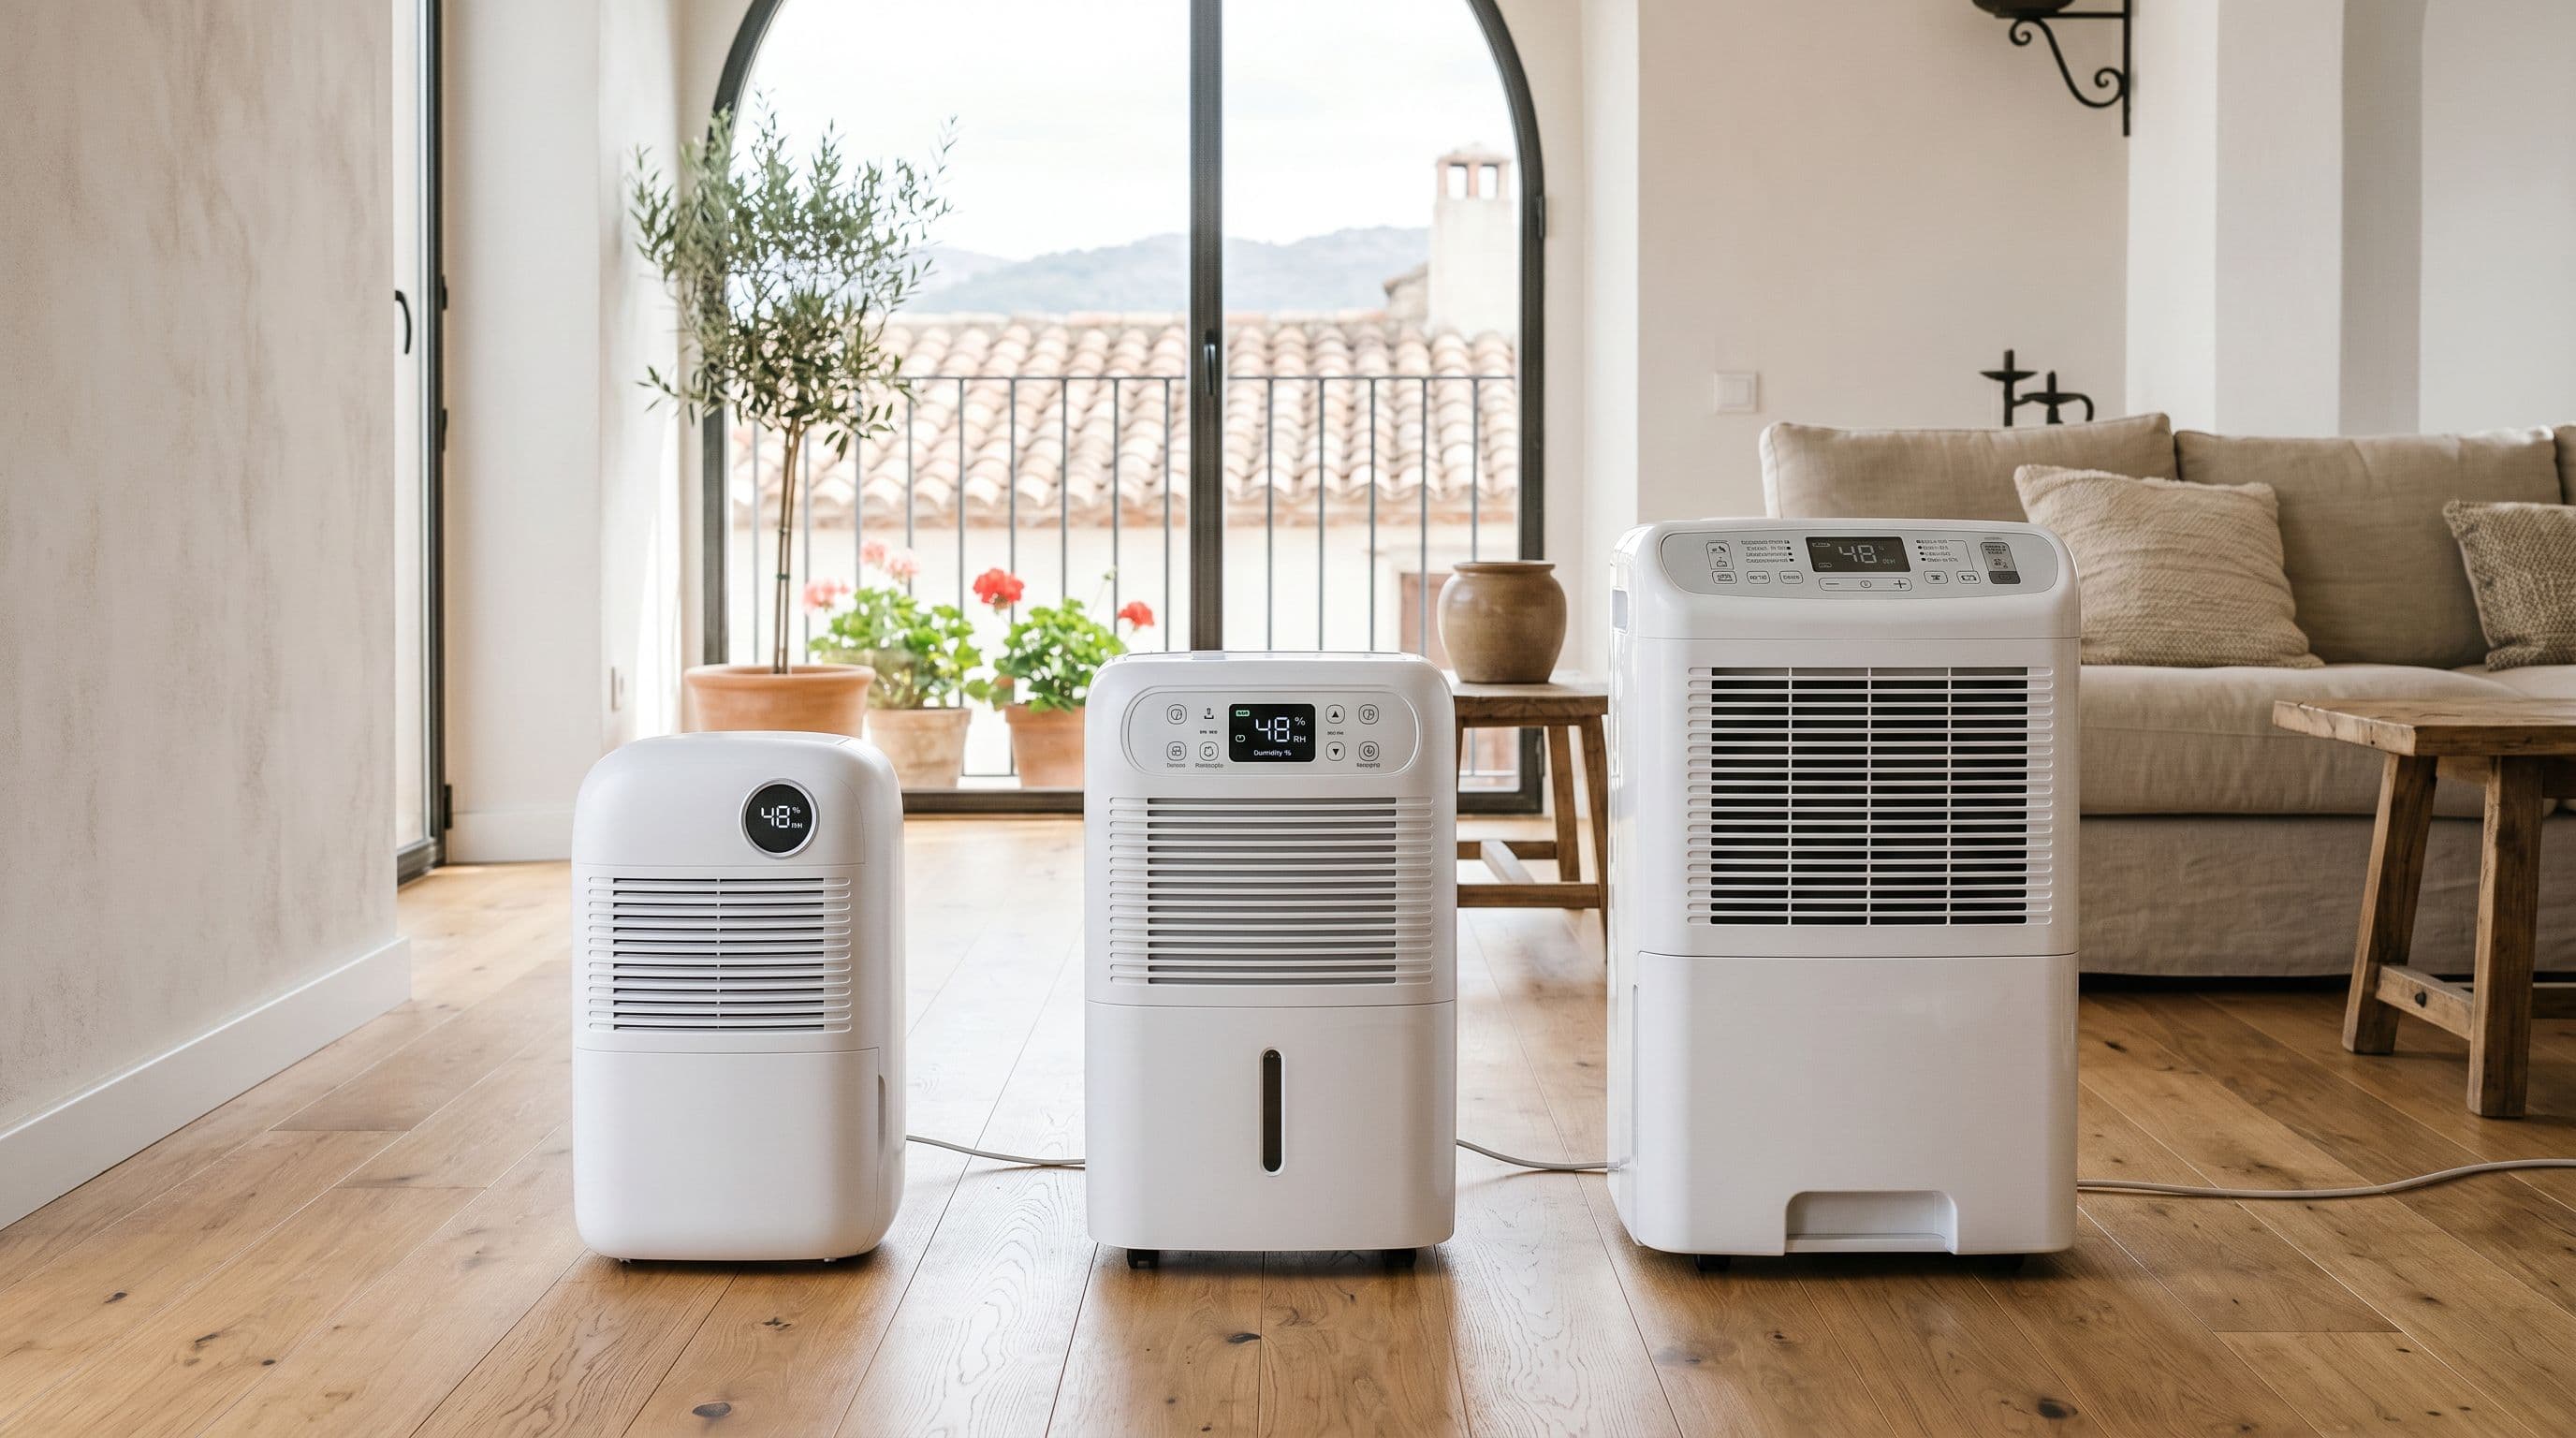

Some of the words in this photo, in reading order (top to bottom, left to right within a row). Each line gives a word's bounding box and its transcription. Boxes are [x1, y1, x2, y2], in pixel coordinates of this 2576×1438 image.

[1837, 545, 1878, 564] 48
[1255, 716, 1290, 742] 48
[1295, 716, 1306, 726] %
[1293, 735, 1307, 743] RH
[761, 805, 790, 829] 48
